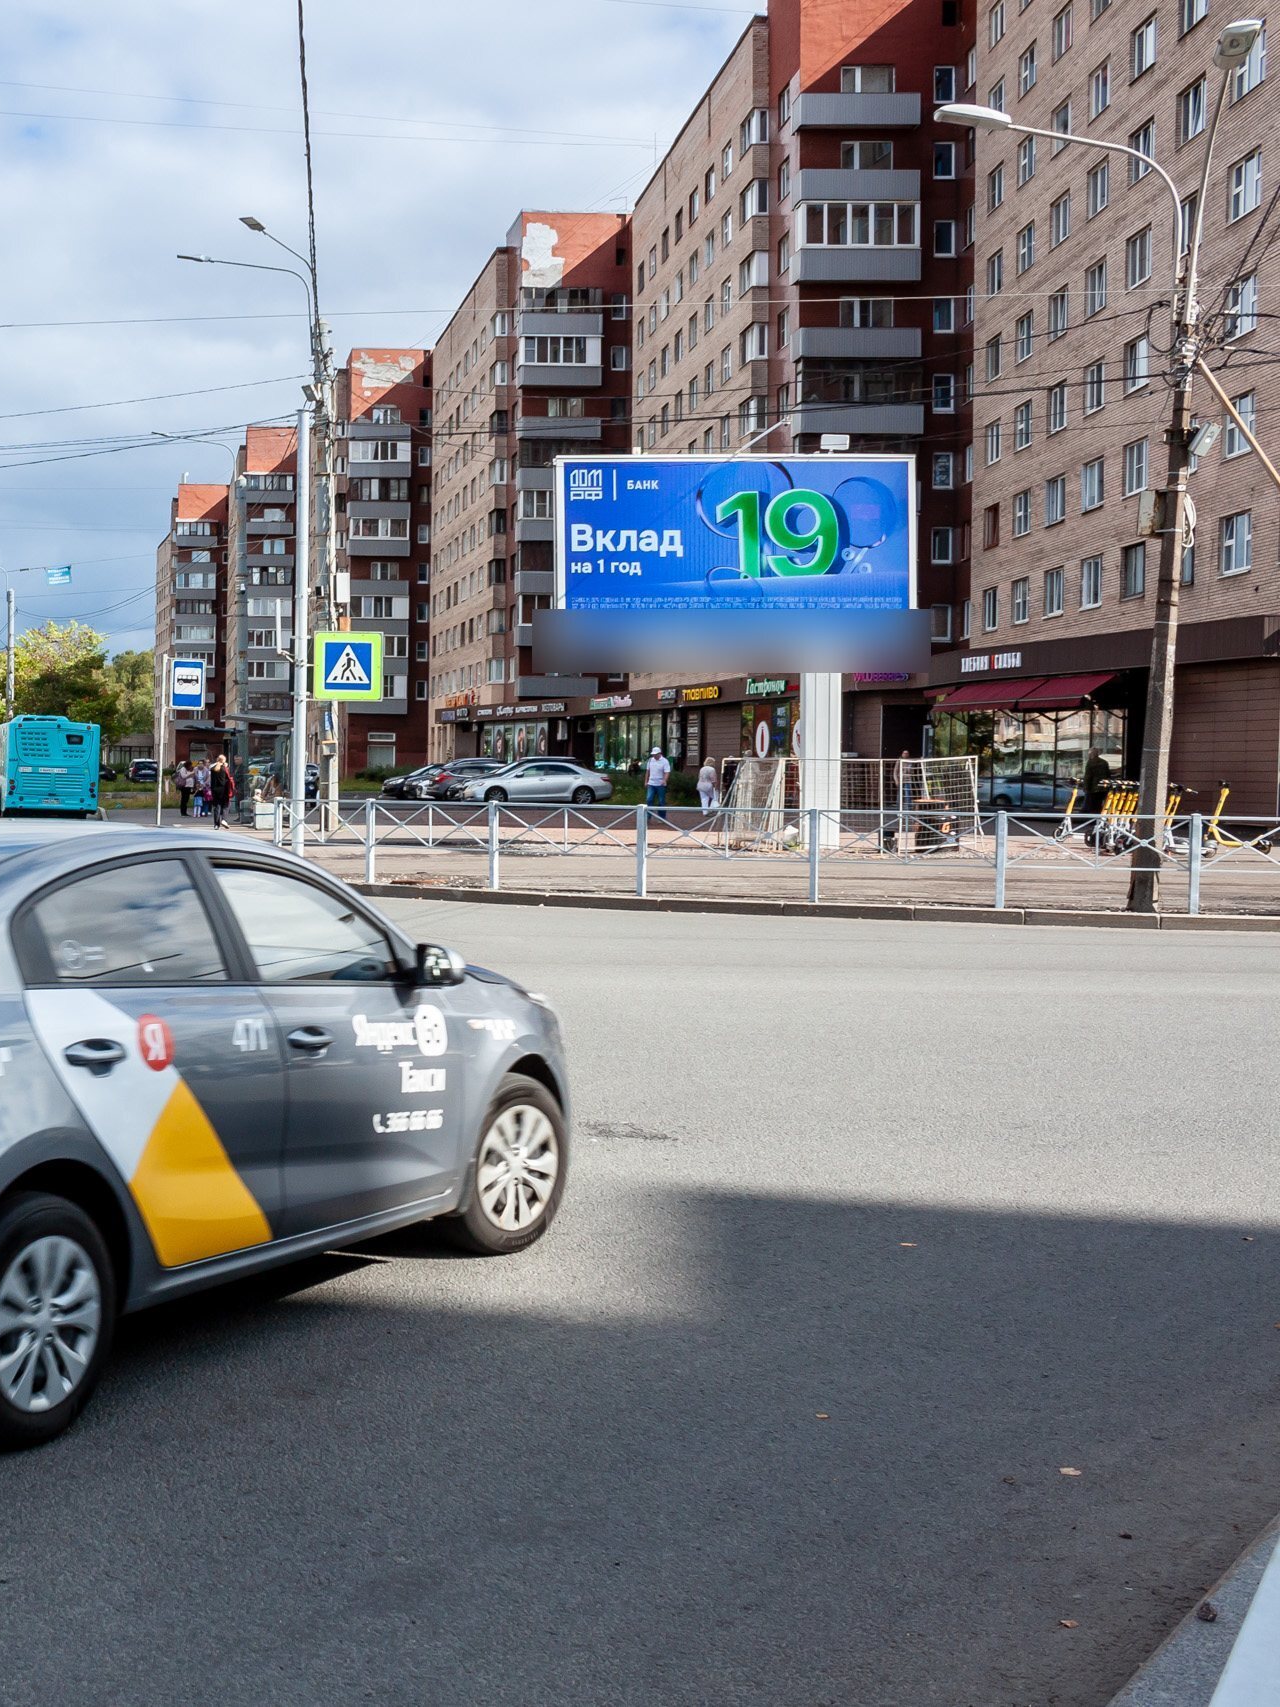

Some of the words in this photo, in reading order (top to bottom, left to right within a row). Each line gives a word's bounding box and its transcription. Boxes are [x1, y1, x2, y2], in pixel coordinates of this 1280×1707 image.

[570, 469, 602, 487] ДОМ
[626, 480, 660, 490] БАНК
[570, 491, 602, 501] РФ
[570, 523, 684, 557] Вклад
[570, 562, 593, 574] на
[597, 559, 605, 573] 1
[610, 562, 642, 576] год
